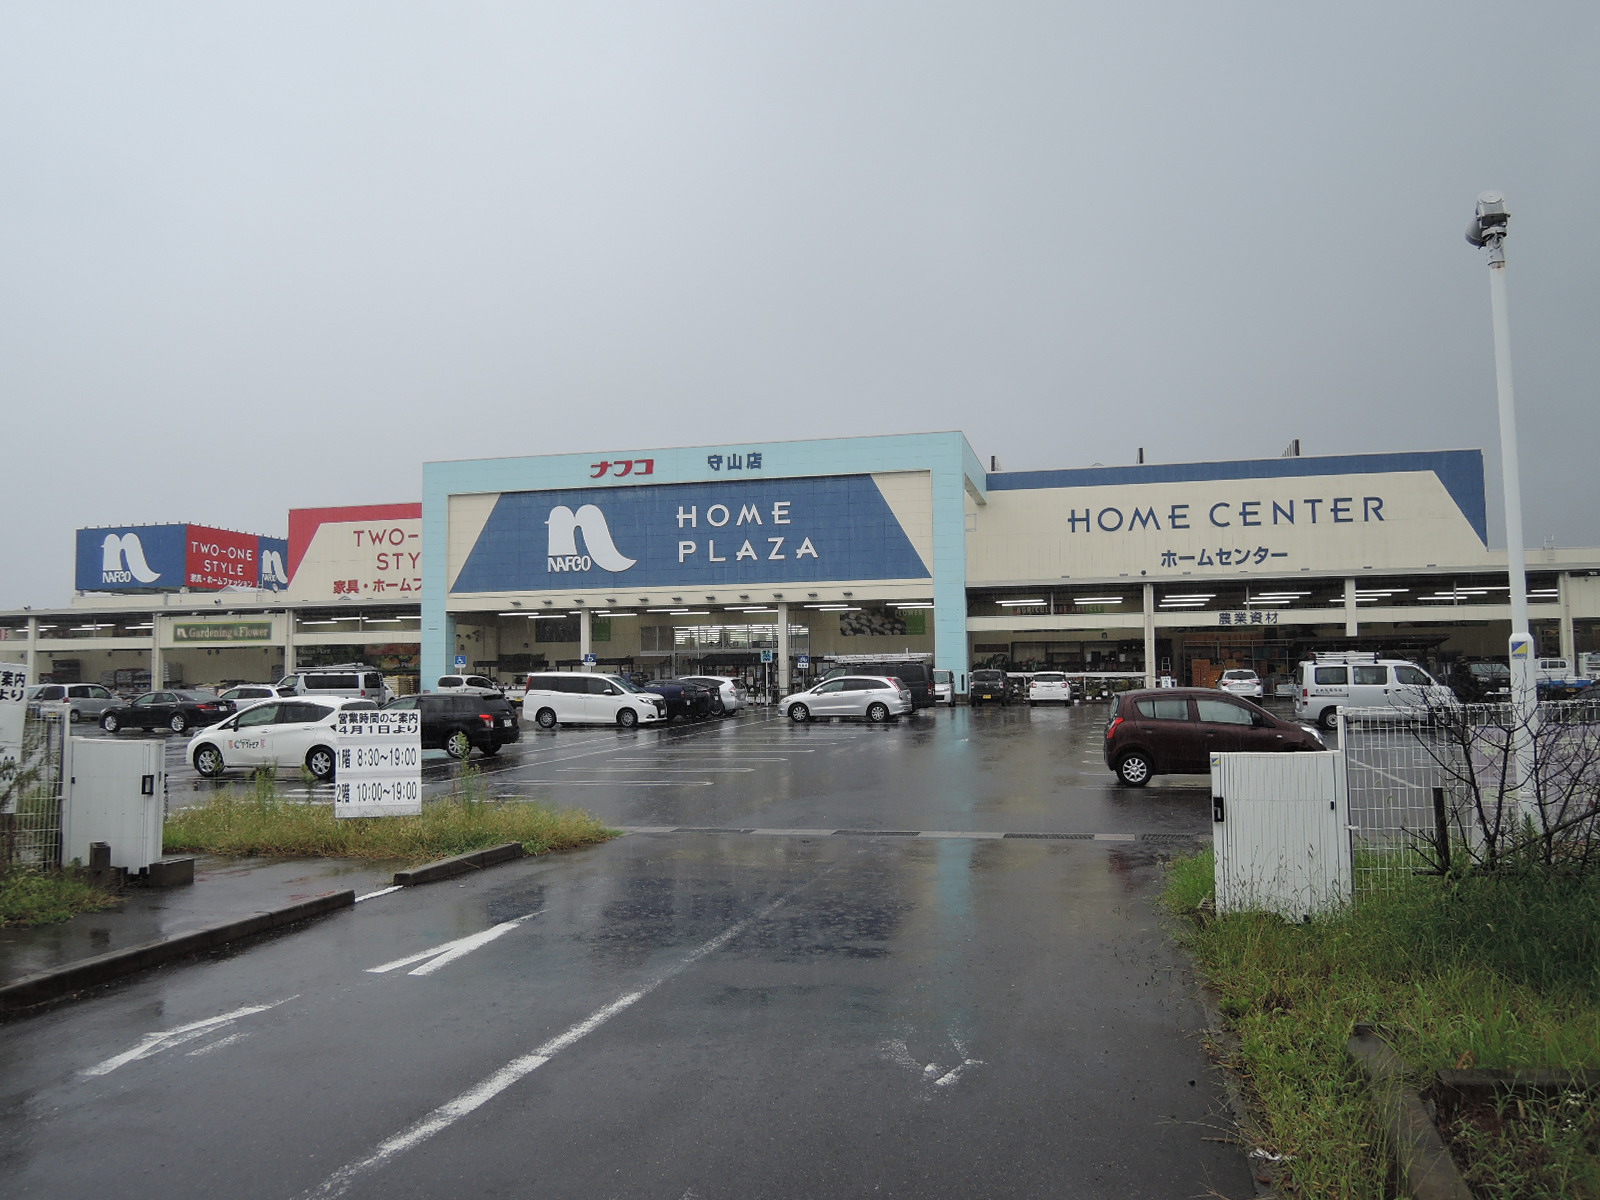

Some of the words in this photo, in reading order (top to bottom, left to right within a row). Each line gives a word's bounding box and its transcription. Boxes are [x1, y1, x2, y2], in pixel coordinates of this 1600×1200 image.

[590, 459, 654, 477] ナフコ
[707, 452, 762, 471] 守山店
[676, 501, 791, 528] HOME
[1068, 504, 1190, 533] HOME
[1208, 496, 1385, 527] CENTER
[353, 528, 418, 547] TWO-
[191, 541, 253, 561] TWO-ONE
[677, 537, 819, 563] PLAZA
[1161, 546, 1288, 567] ホームセンター
[204, 560, 244, 576] STYLE
[376, 552, 421, 571] STY
[547, 555, 591, 572] NAFCO
[102, 570, 131, 583] NAFCO
[1218, 612, 1279, 625] 農業資材
[189, 627, 233, 640] Gardening
[239, 626, 268, 637] Flower
[338, 712, 418, 724] 営業時間のご案内
[336, 748, 351, 768] 1階
[336, 783, 350, 803] 2階
